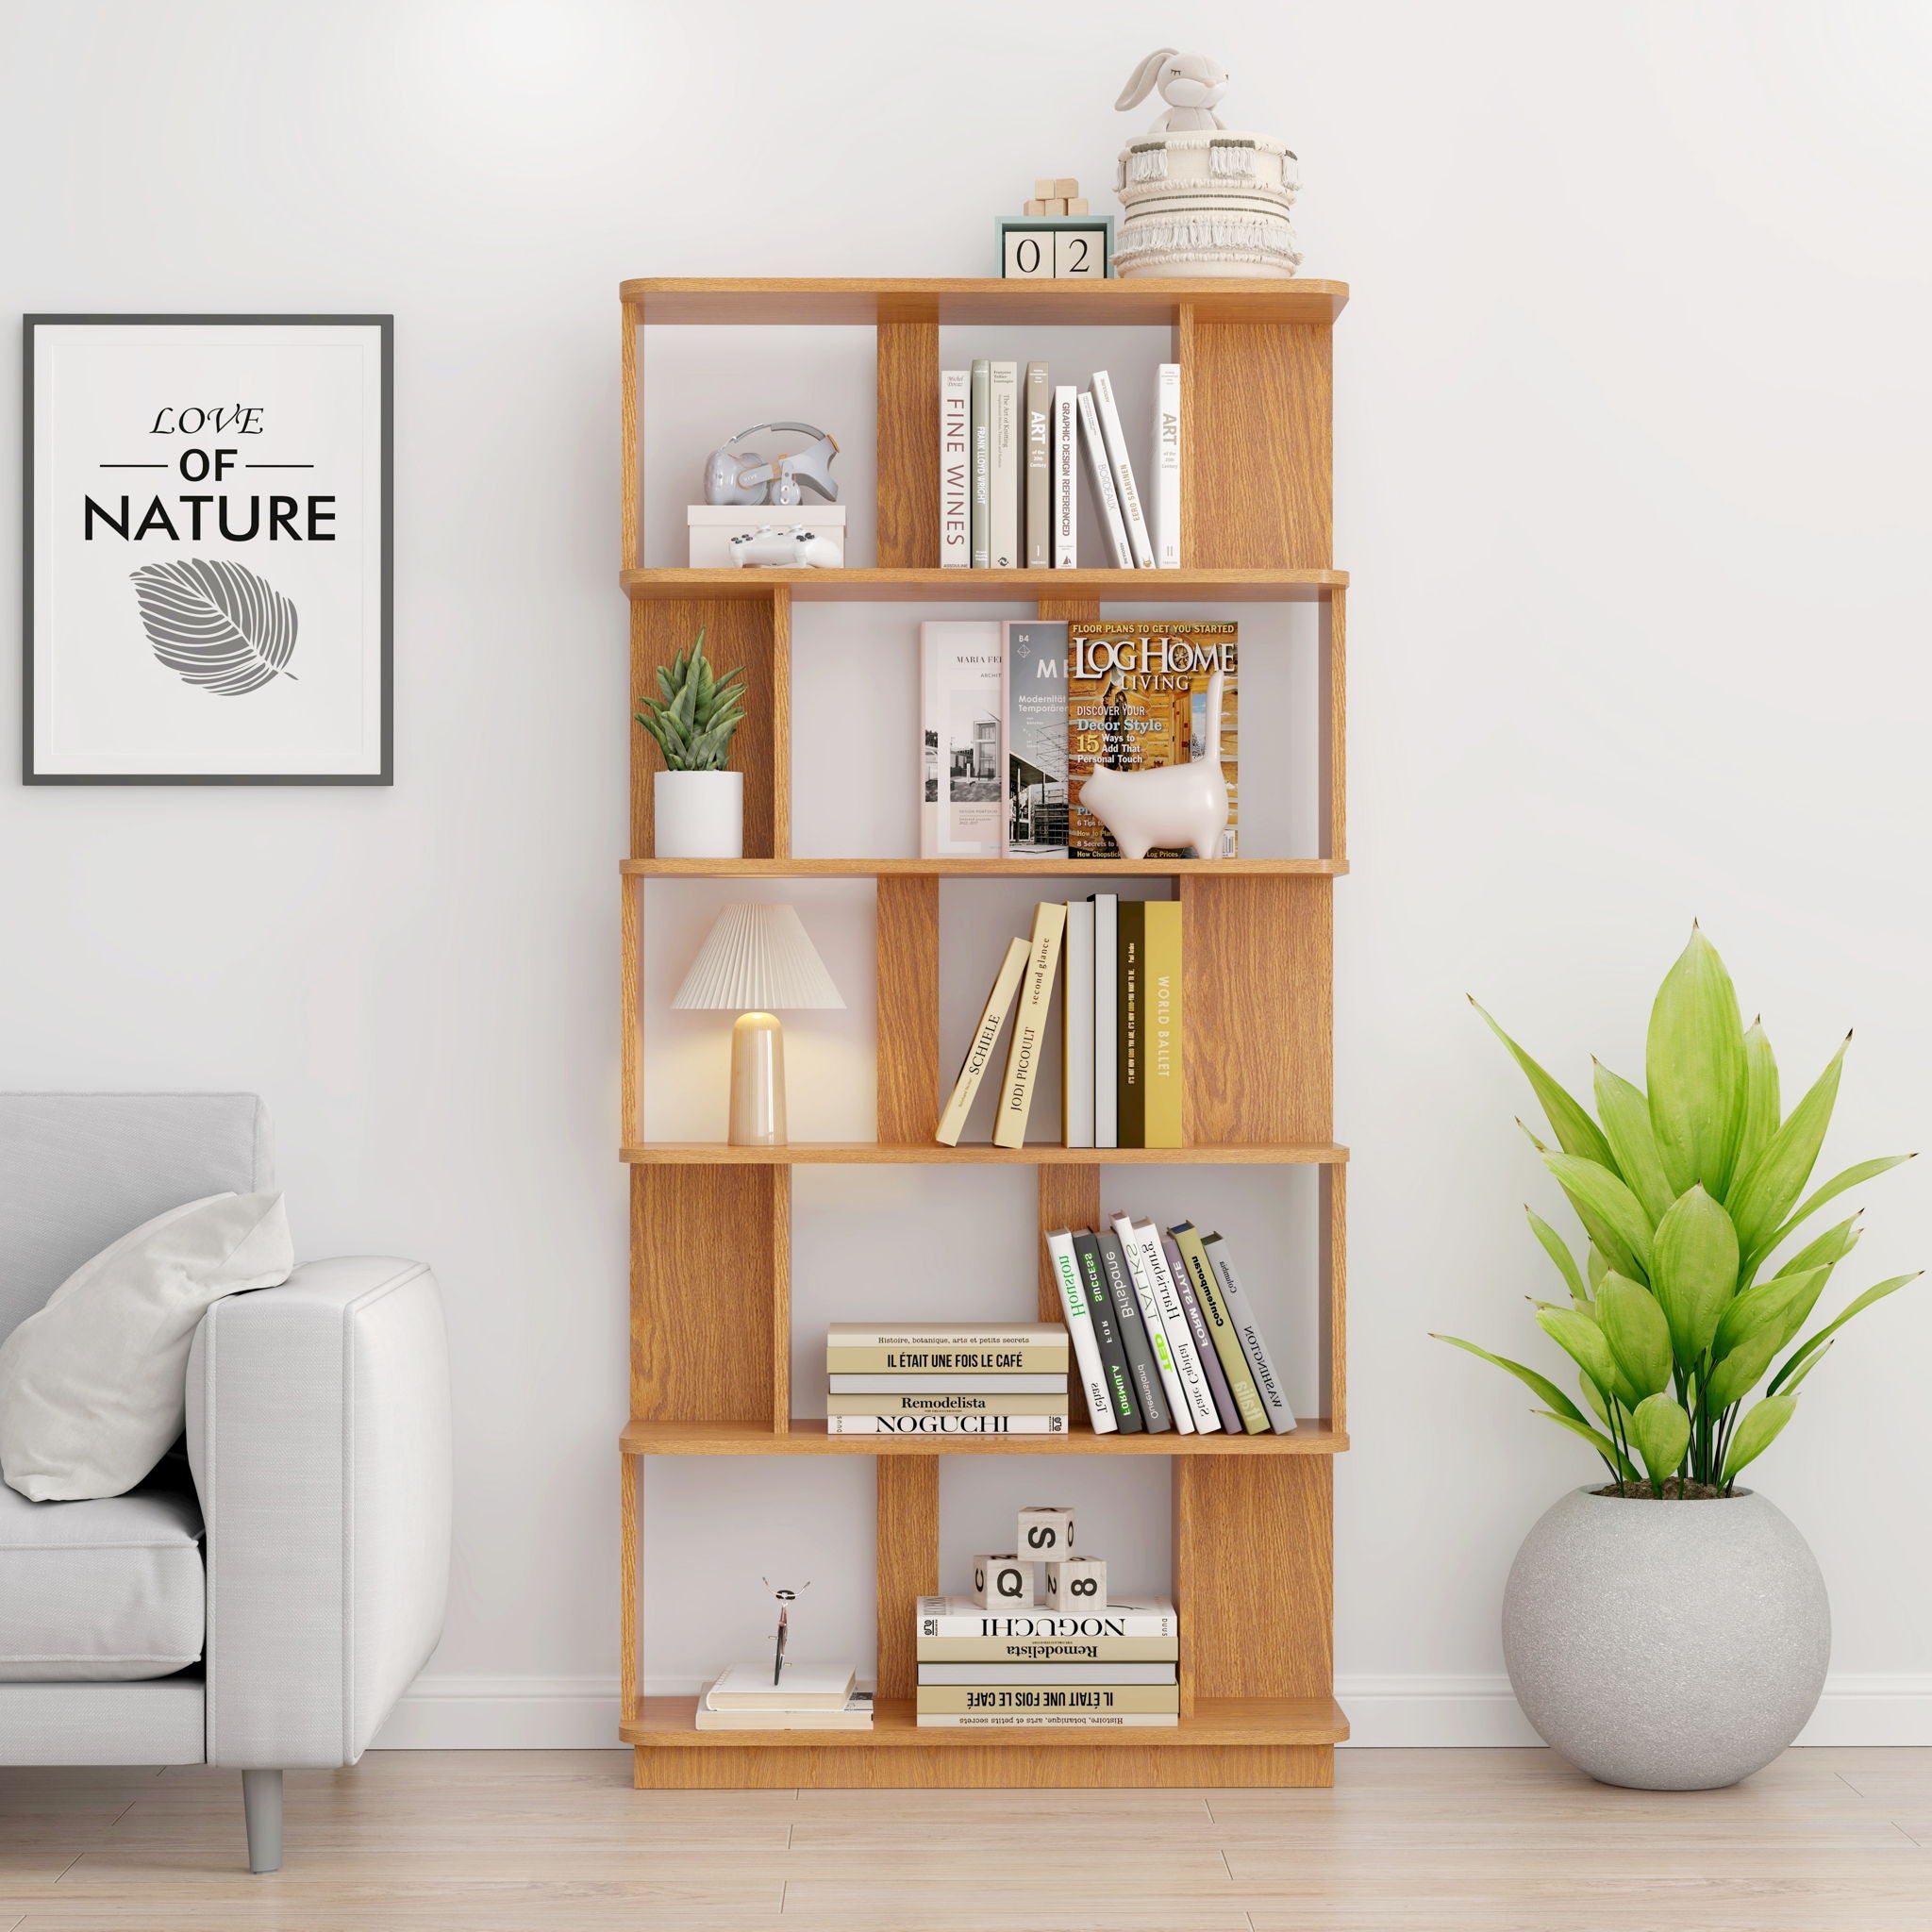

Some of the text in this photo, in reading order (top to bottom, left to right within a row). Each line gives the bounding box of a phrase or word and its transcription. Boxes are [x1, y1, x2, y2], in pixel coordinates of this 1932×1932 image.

[1016, 239, 1091, 274] 0 2
[149, 403, 264, 435] LOVE
[946, 399, 965, 453] FINE
[1031, 411, 1046, 444] ART
[1062, 402, 1071, 441] GRAPHIC
[1162, 413, 1177, 445] ART
[1002, 425, 1010, 448] Knitting
[179, 448, 238, 482] OF
[976, 426, 986, 505] FRANK LLOYD WRIGHT
[1062, 443, 1071, 476] DESIGN
[1098, 464, 1117, 510] BORDEAUX
[1120, 464, 1141, 522] EERO SAARINEN
[946, 464, 965, 545] WINES
[1062, 478, 1071, 536] REFERENCED
[85, 493, 336, 542] NATURE
[1073, 625, 1235, 633] FLOOR PLANS TO GET YOU STARTED
[1121, 675, 1190, 691] LIVING
[1076, 707, 1145, 716] DISCOVER YOUR
[1077, 718, 1162, 734] Decor Style
[1076, 735, 1100, 753] 15
[1102, 734, 1135, 743] Ways to
[1102, 744, 1141, 753] Add That
[1077, 755, 1142, 763] Personal Touch
[1032, 938, 1050, 1006] second glance
[1158, 975, 1170, 1077] WORLD BALLET
[968, 1014, 1001, 1075] SCHIELE
[1010, 1026, 1036, 1112] JODI PICOULT
[911, 1337, 950, 1345] botanique,
[979, 1337, 1001, 1345] petits
[887, 1352, 1023, 1367] IL ÉTAIT UNE FOIS LE CAFÉ
[901, 1397, 986, 1408] Remodelista
[875, 1416, 1009, 1433] NOGUCHI
[1027, 1526, 1056, 1549] S
[996, 1568, 1024, 1599] Q
[1071, 1577, 1097, 1596] 8
[981, 1619, 1125, 1636] NOGUCHI
[1007, 1645, 1098, 1657] Remodelista
[967, 1692, 1113, 1709] IL ÉTAIT UNE FOIS LE CAFÉ
[991, 1716, 1014, 1724] petits
[1045, 1716, 1086, 1724] botanique,
